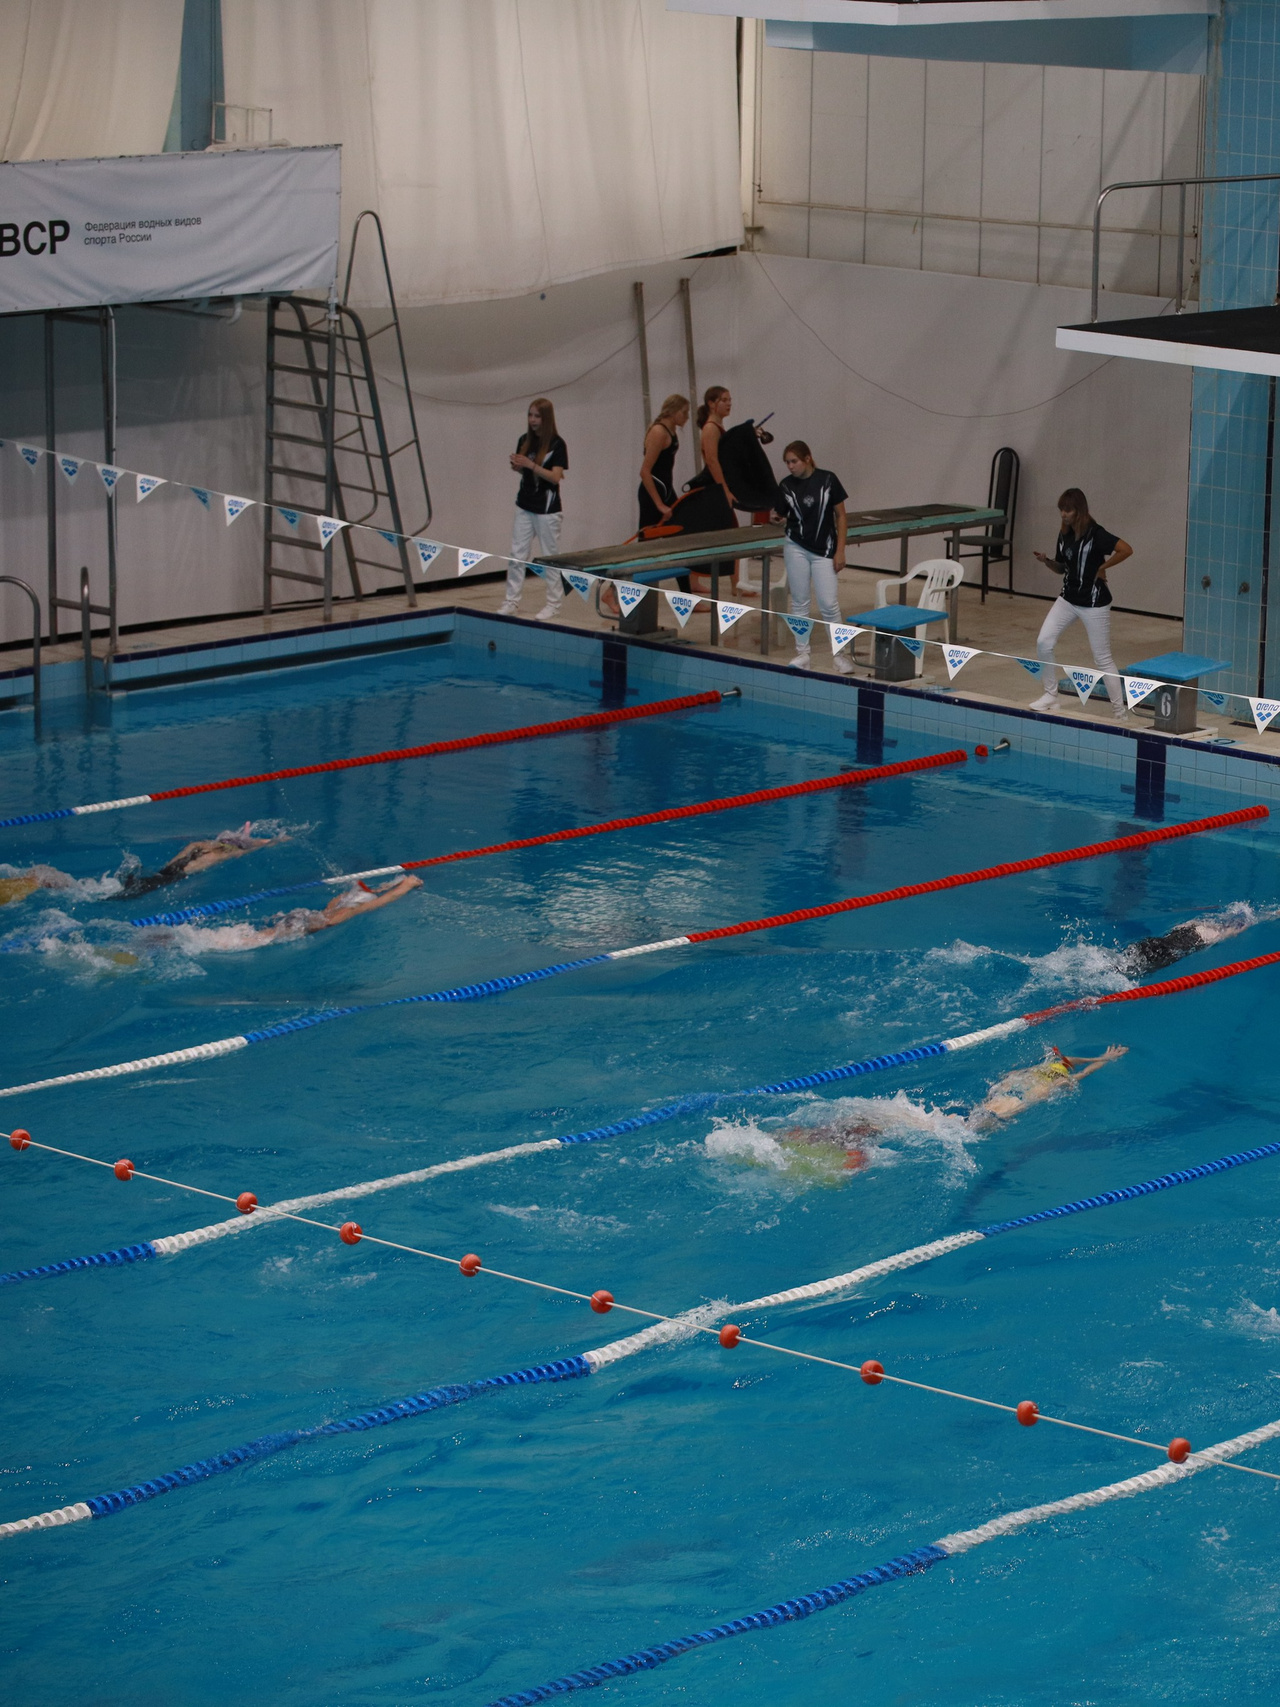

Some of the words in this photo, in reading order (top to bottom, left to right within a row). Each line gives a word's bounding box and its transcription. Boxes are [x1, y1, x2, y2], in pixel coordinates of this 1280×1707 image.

[85, 221, 136, 232] Федерация
[139, 218, 172, 229] водных
[175, 216, 202, 226] видов
[84, 235, 117, 246] спорта
[119, 232, 152, 243] России
[620, 585, 641, 597] arena
[672, 596, 692, 608] arena
[721, 605, 744, 614] arena
[787, 616, 809, 627] arena
[834, 626, 857, 636] arena
[948, 649, 970, 659] arena
[1072, 671, 1094, 684] arena
[1129, 680, 1153, 690] arena
[1161, 692, 1172, 717] 6
[1256, 702, 1280, 712] arena
